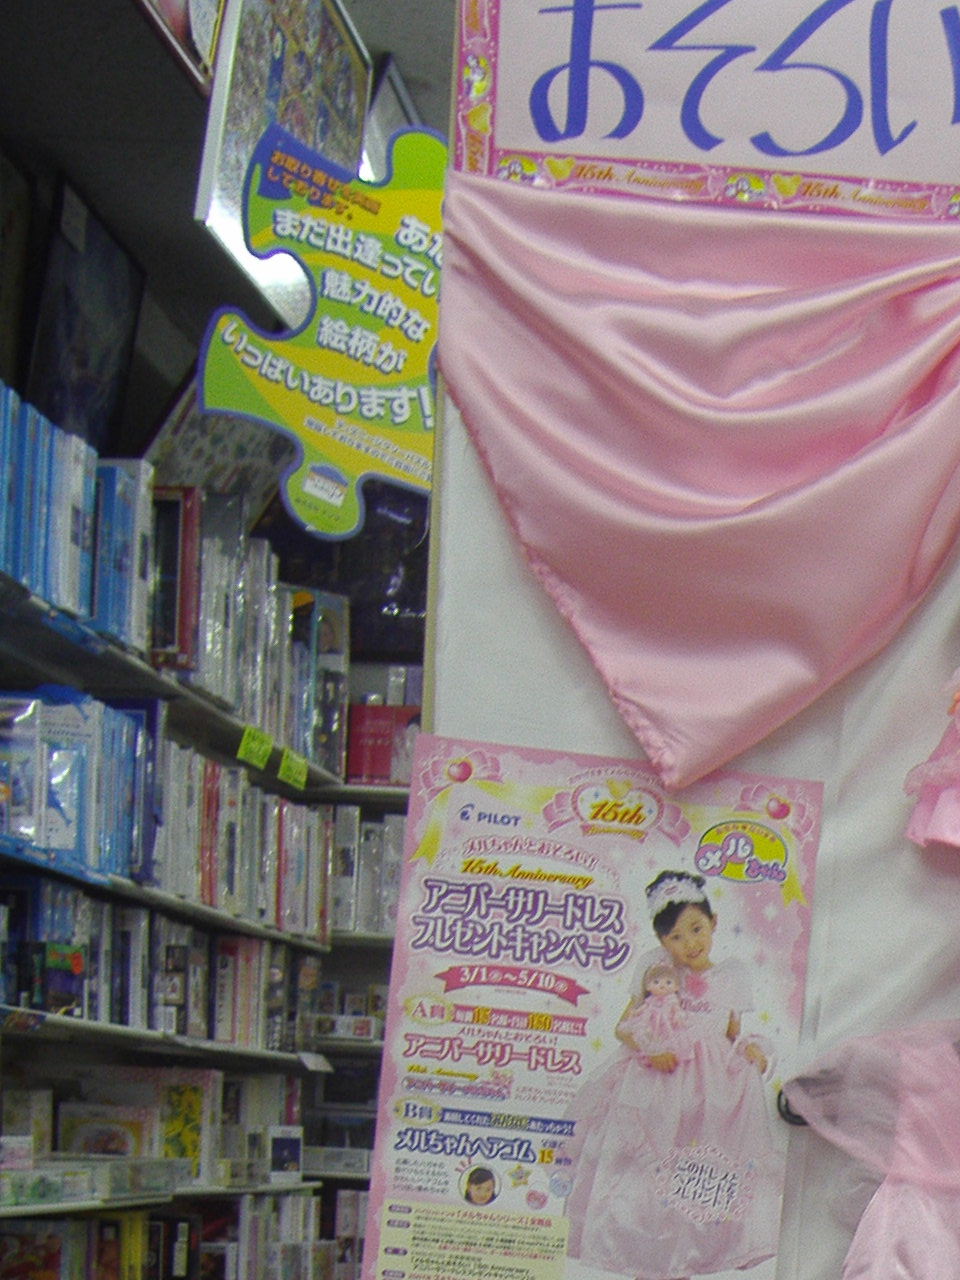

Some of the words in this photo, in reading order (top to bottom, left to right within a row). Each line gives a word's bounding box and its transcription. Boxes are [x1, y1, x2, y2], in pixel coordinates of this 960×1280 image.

[321, 268, 432, 343] 魅力的な
[317, 315, 407, 374] 絵柄が
[477, 811, 521, 827] PILOT
[461, 856, 499, 876] 15th
[501, 863, 595, 890] Anniversary
[421, 878, 625, 935] アニバーサリードレス
[410, 915, 631, 972] プレゼントキャンペーン
[402, 1032, 583, 1076] アニバーサリードレス
[394, 1126, 537, 1163] メルちゃんヘアゴム
